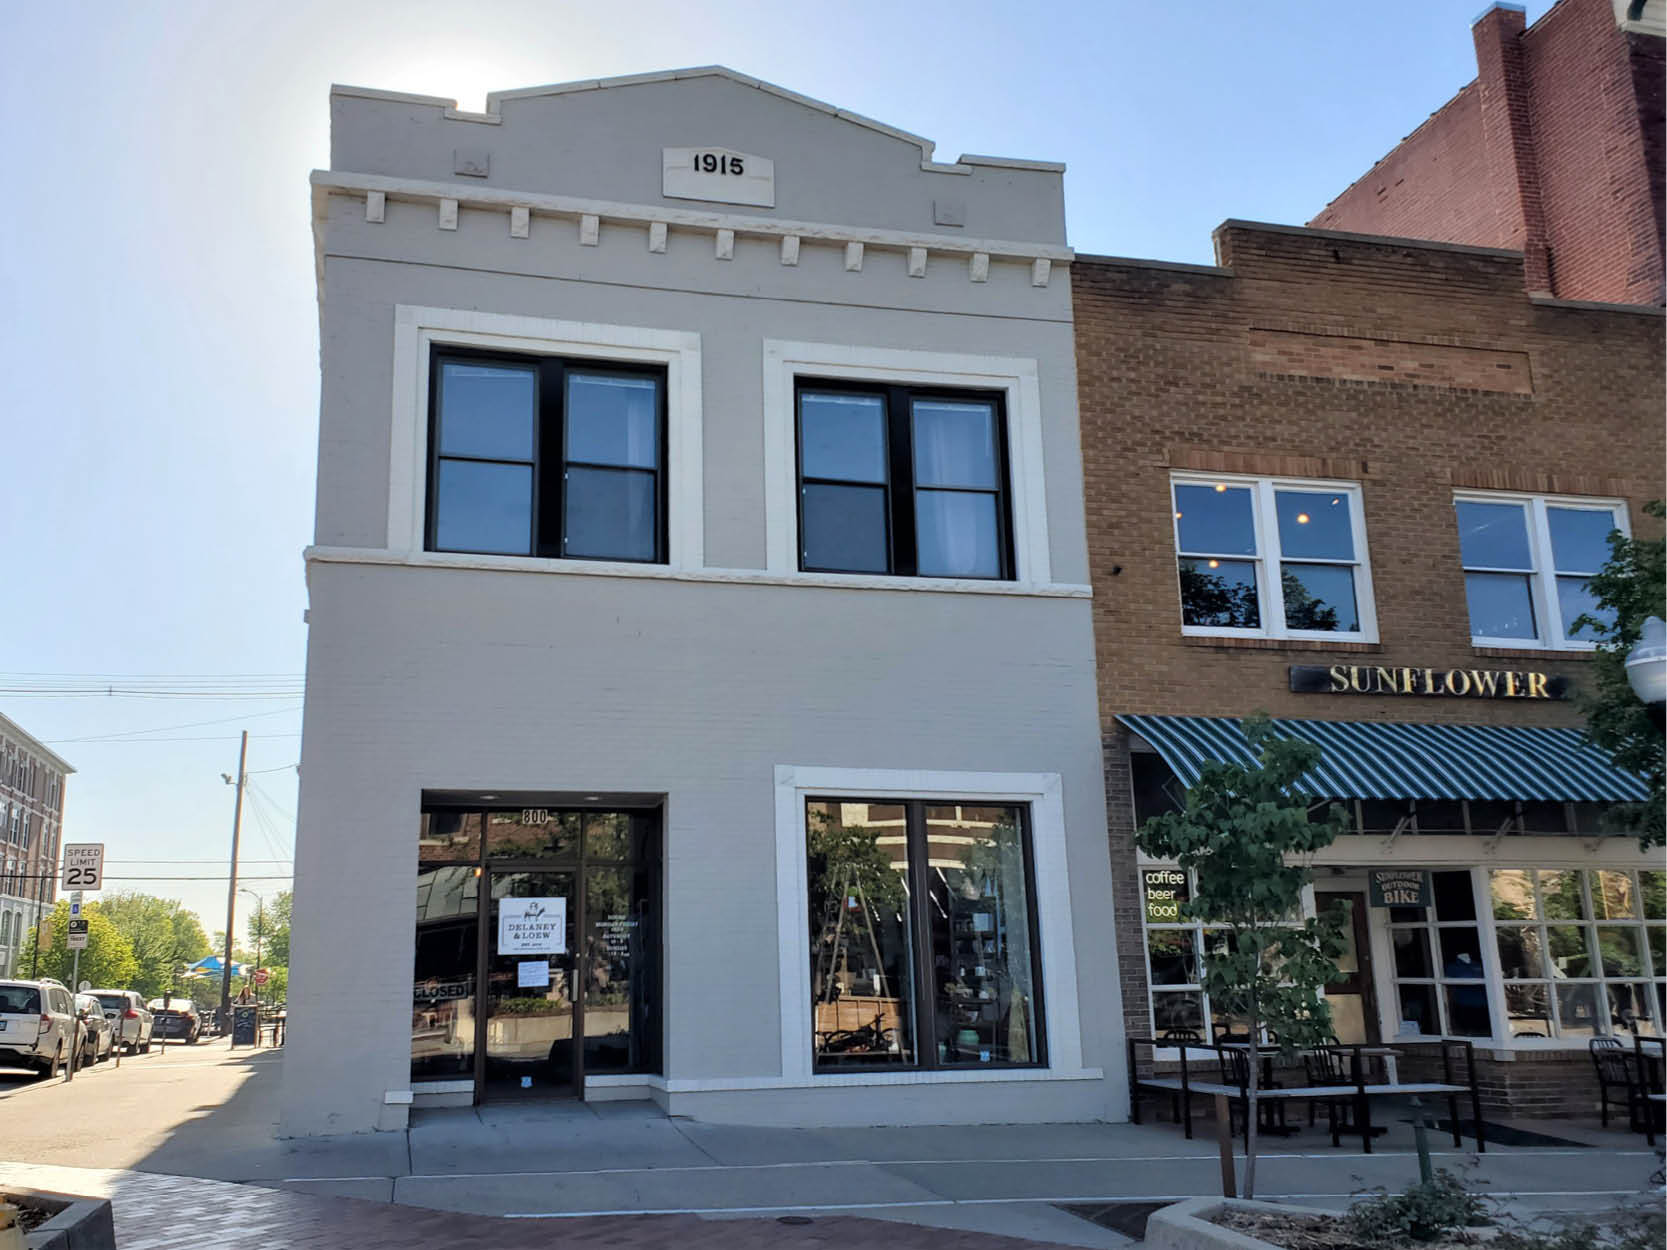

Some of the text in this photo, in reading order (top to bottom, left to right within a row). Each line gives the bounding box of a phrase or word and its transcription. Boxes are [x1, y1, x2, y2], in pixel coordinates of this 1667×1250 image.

[694, 153, 744, 175] 1915
[1329, 664, 1550, 698] SUNFLOWER
[524, 810, 546, 823] 800
[67, 849, 100, 857] SPEED
[67, 868, 97, 885] 25
[1145, 870, 1185, 884] coffee
[1147, 886, 1176, 900] beer
[1383, 890, 1420, 904] BIKE
[1147, 902, 1178, 917] food
[508, 923, 556, 931] DELANEY
[522, 931, 551, 939] LOEW
